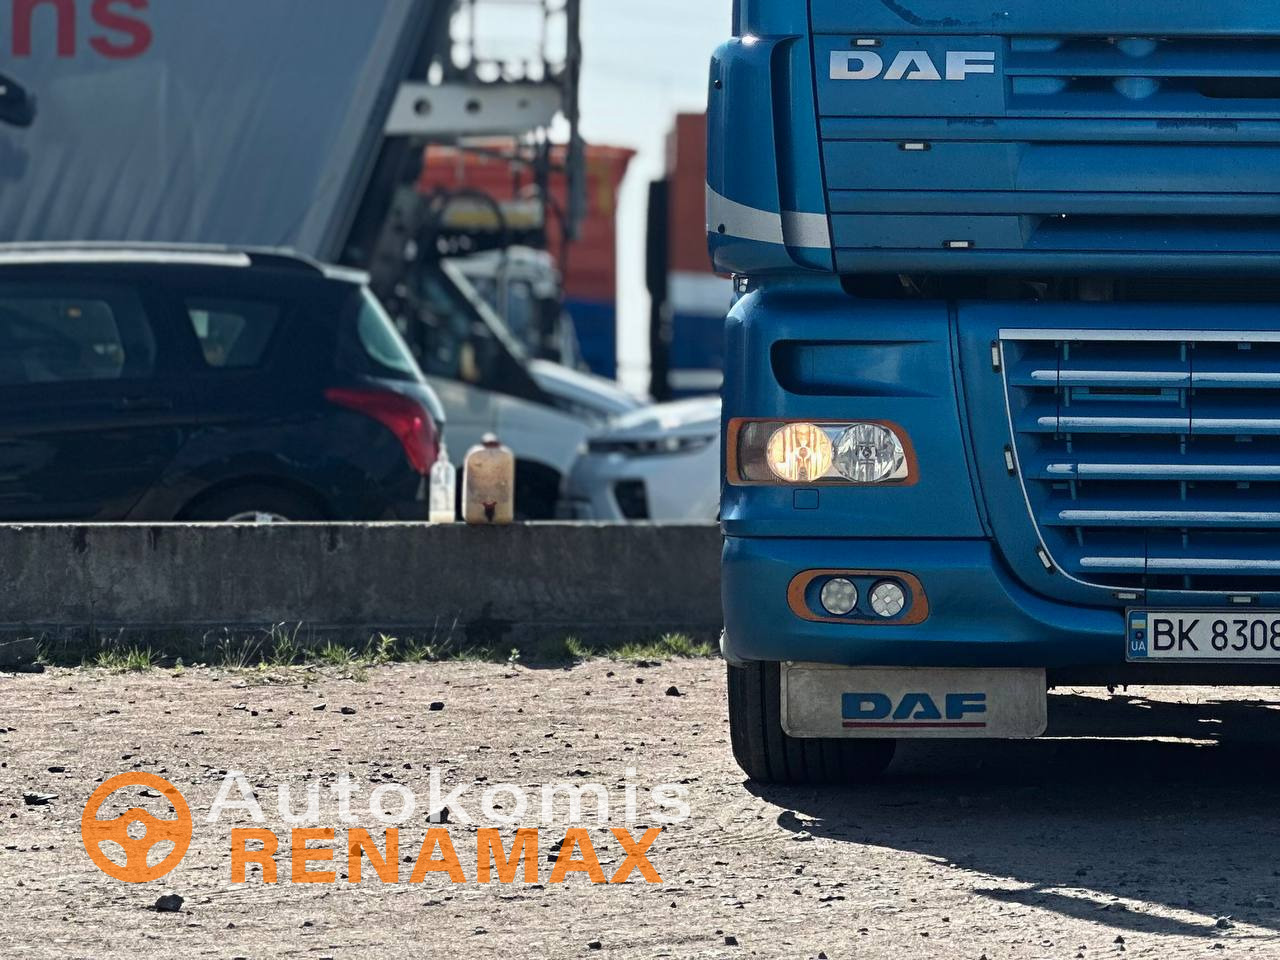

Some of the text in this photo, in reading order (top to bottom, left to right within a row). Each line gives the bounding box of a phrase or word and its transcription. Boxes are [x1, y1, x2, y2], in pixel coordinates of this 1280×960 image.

[829, 50, 995, 81] DAF
[1131, 641, 1146, 652] UA
[1153, 619, 1200, 652] BK
[841, 692, 987, 721] DAF
